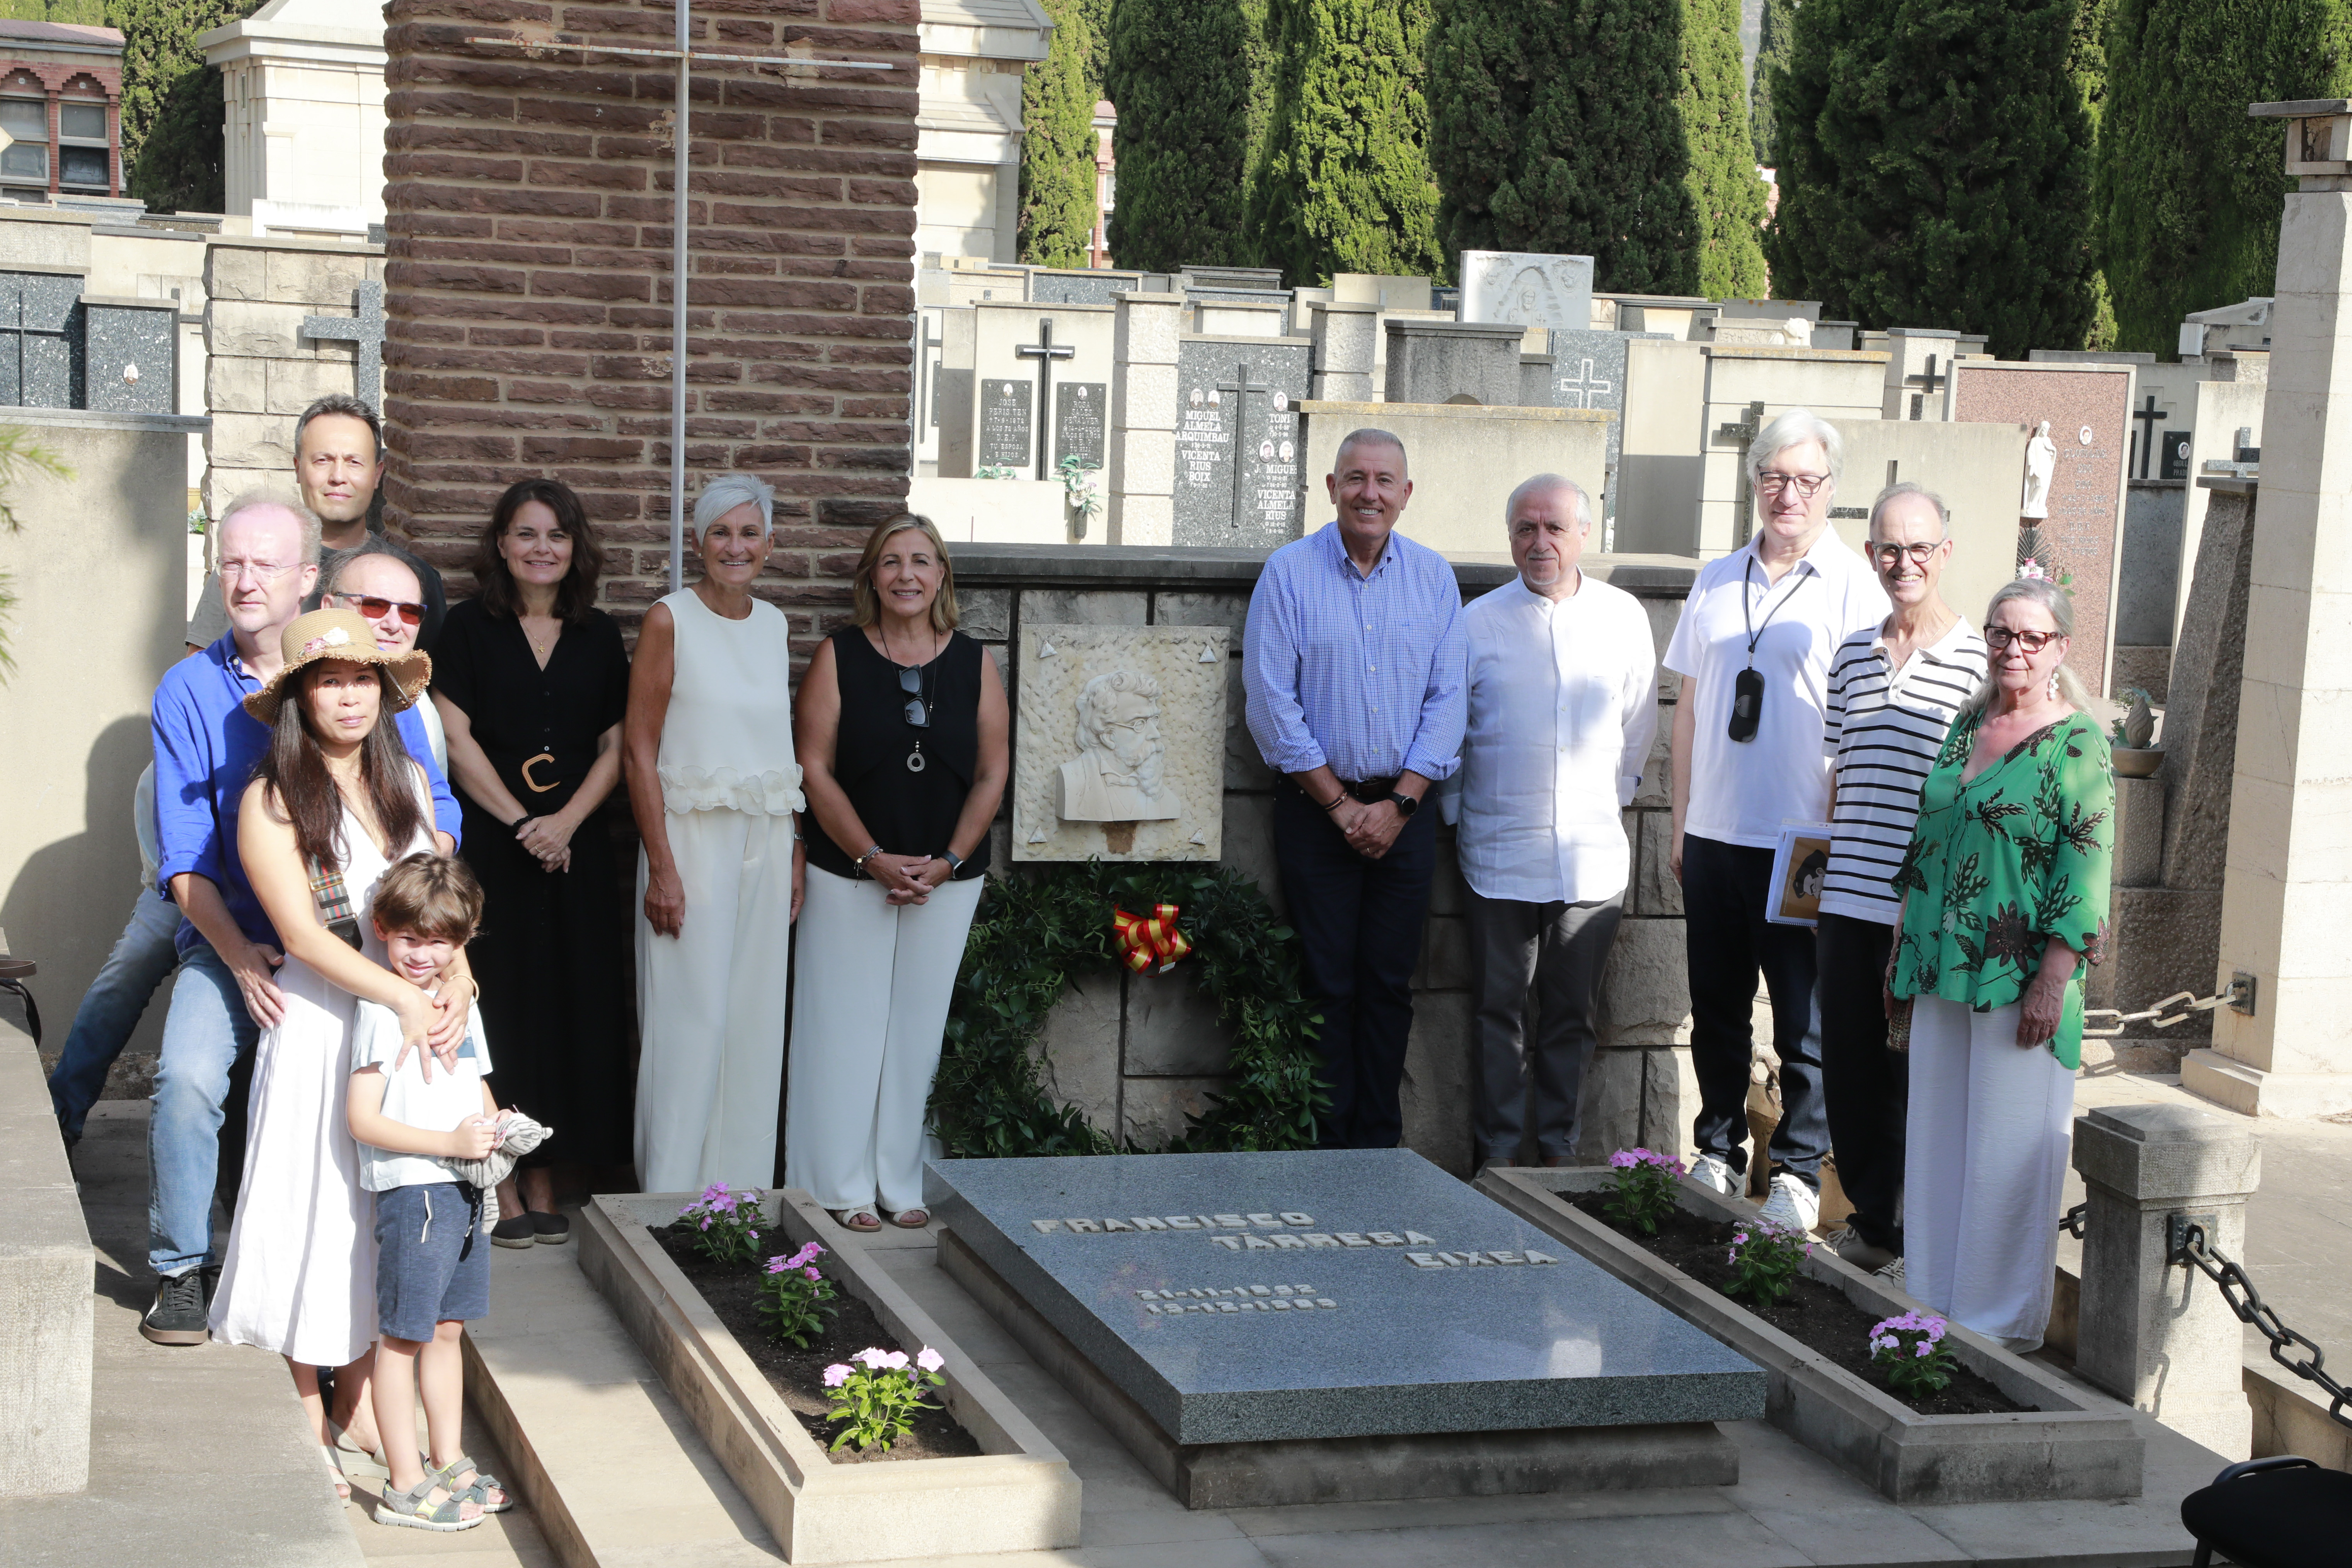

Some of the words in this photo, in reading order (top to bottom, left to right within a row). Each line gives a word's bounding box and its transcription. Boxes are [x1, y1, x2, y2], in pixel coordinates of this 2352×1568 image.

[90, 396, 170, 412] ANTONIA
[1064, 416, 1099, 424] PEÑALVER
[1185, 410, 1221, 421] MIGUEL
[1269, 414, 1290, 423] TONI
[1183, 421, 1222, 432] ALMELA
[1175, 431, 1230, 442] ARQUIMBAU
[1181, 450, 1221, 461] VICENTA
[1190, 461, 1211, 471] RIUS
[1189, 471, 1210, 481] BOIX
[1257, 489, 1296, 499] VICENTA
[1257, 500, 1295, 510] ALMELA
[1265, 511, 1287, 520] RIUS
[1032, 1212, 1315, 1233] FRANCISCO
[1406, 1249, 1558, 1268] EIXEA
